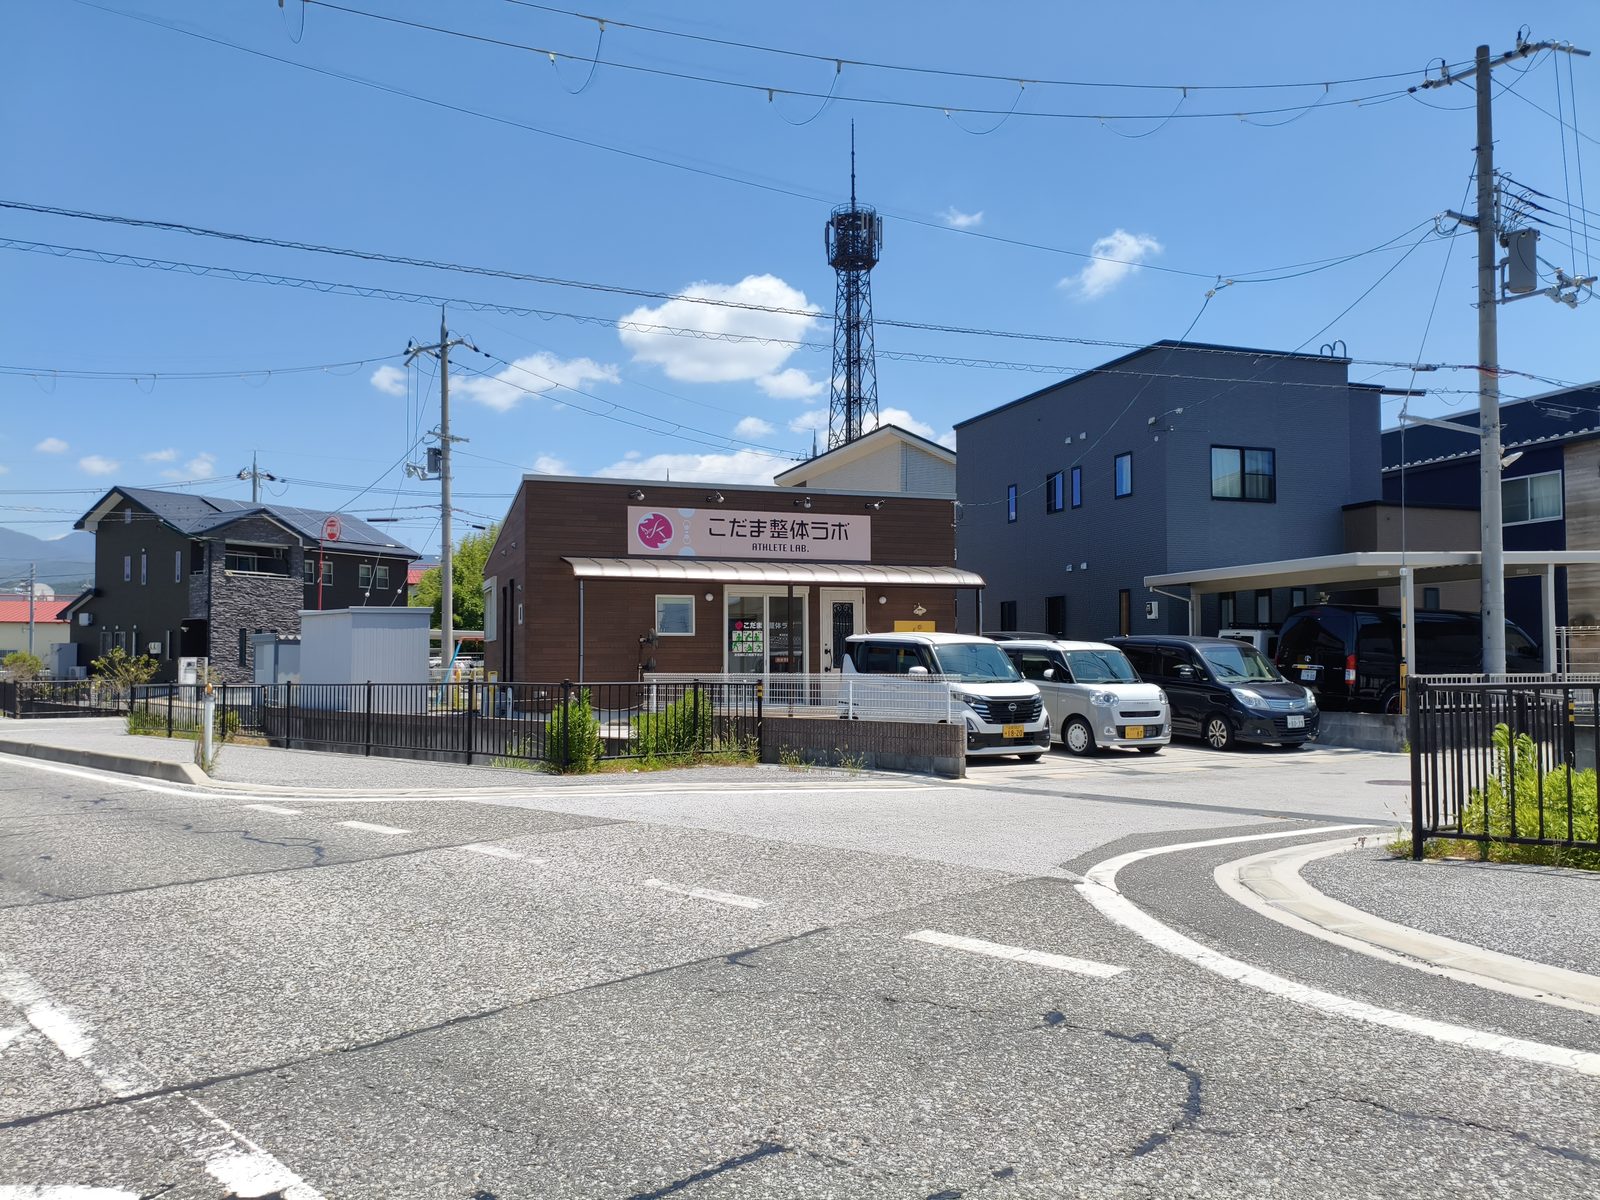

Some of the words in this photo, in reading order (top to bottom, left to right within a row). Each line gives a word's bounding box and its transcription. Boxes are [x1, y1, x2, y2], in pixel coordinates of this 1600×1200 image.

[709, 518, 850, 541] こだま整体ラボ
[752, 543, 787, 552] ATHLETE
[790, 543, 809, 553] LAB.
